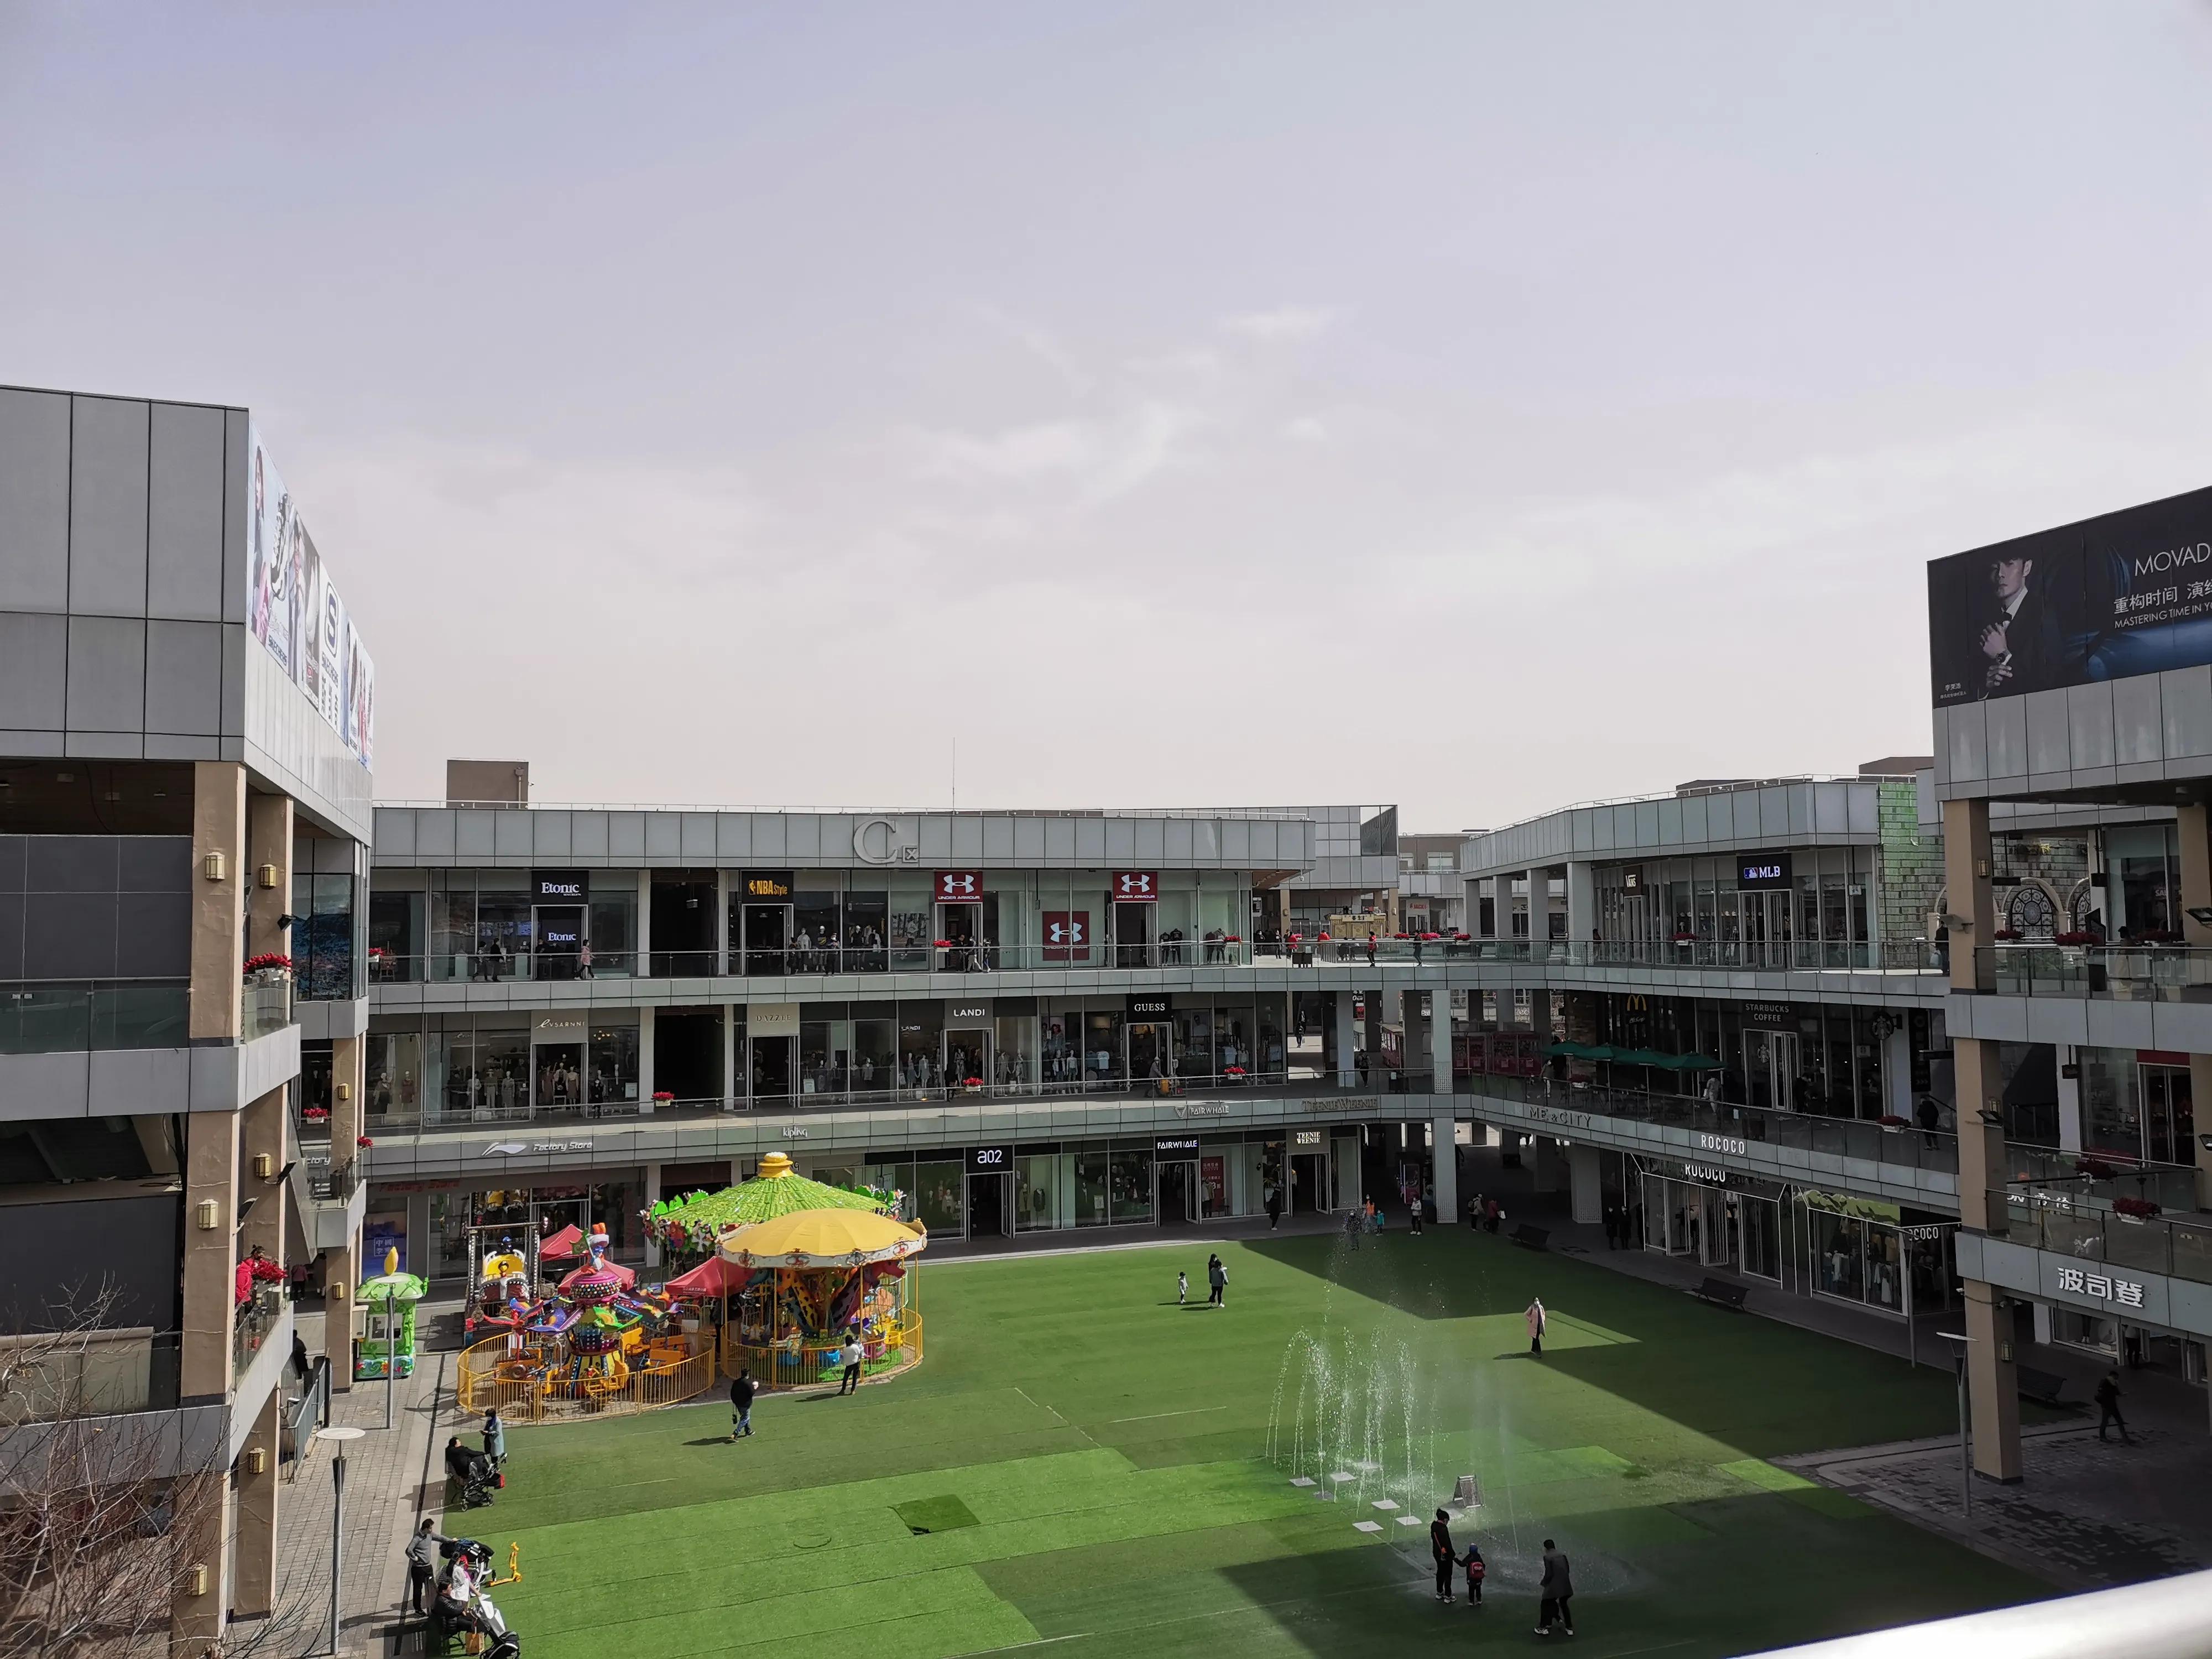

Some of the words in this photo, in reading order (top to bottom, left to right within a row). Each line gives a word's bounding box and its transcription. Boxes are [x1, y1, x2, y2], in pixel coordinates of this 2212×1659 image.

[2135, 542, 2212, 576] MOVAD
[2114, 586, 2178, 614] 重构时间
[2114, 611, 2167, 628] MASTERING
[2168, 606, 2190, 618] TIME
[2192, 603, 2202, 613] IN
[2204, 601, 2212, 611] Y
[1759, 865, 1780, 878] MLB
[541, 881, 580, 894] Etonic
[757, 880, 774, 895] NBA
[547, 932, 577, 941] Etonic
[953, 1009, 985, 1017] LANDI
[1134, 1003, 1165, 1011] GUESS
[1745, 1003, 1790, 1013] STARBUCKS
[756, 1014, 791, 1022] DAZZLE
[1754, 1013, 1781, 1022] COFFEE
[1190, 1105, 1230, 1115] FAIRWHALE
[533, 1143, 567, 1152] Factory
[568, 1141, 593, 1150] Store
[1701, 1134, 1745, 1154] ROCOCO
[977, 1149, 1003, 1164] a02
[1685, 1164, 1725, 1182] ROCOCO
[2057, 1267, 2143, 1308] 波司登
